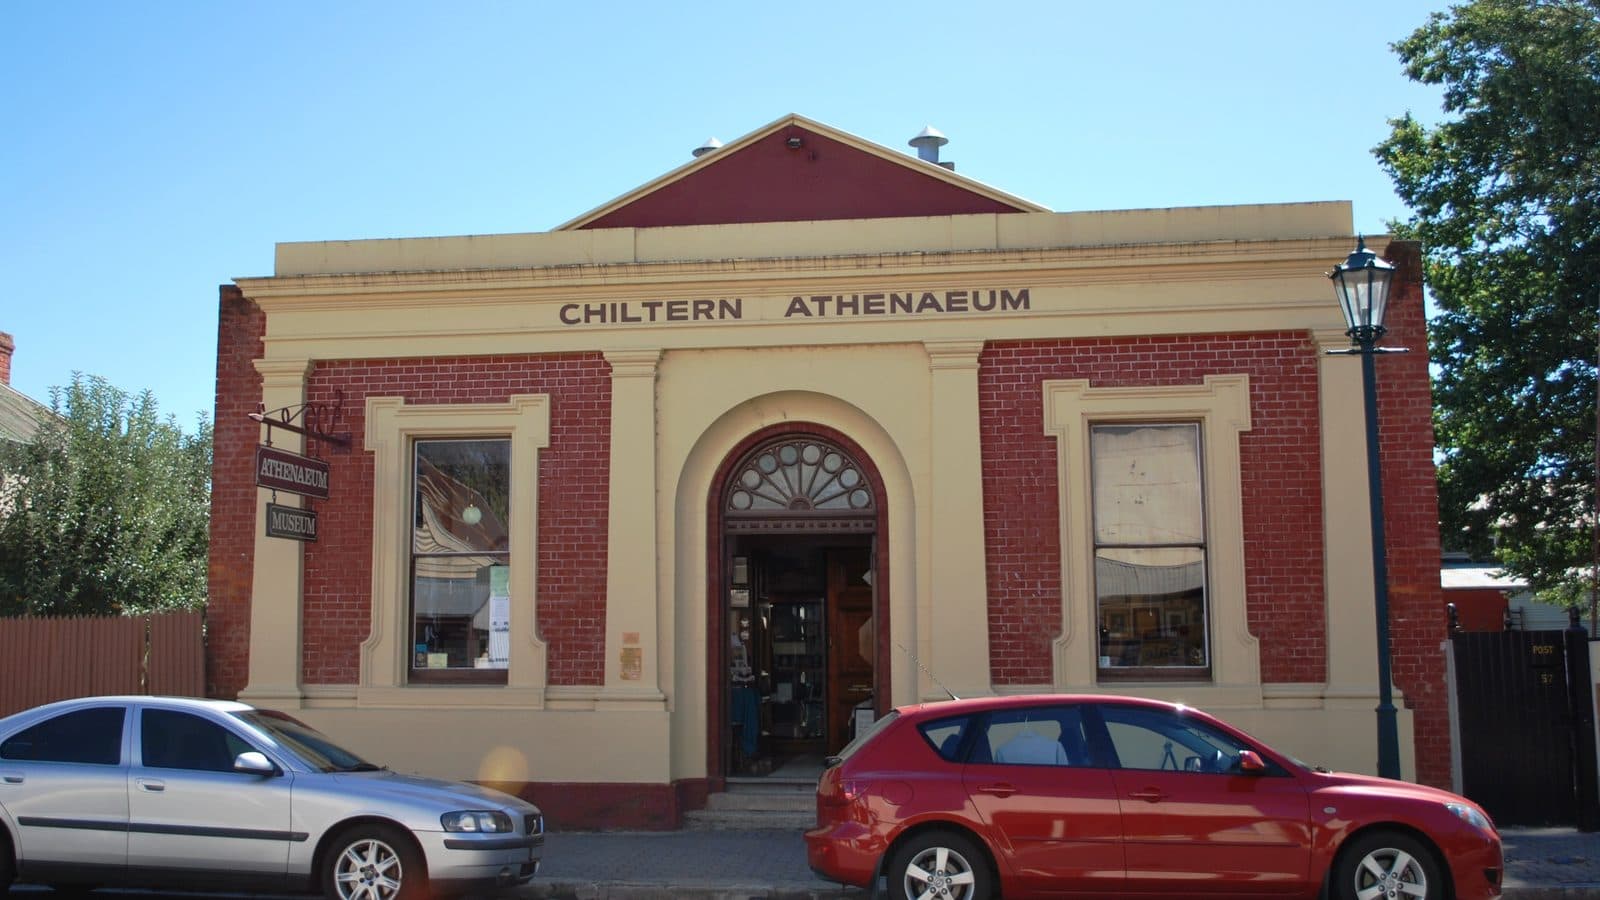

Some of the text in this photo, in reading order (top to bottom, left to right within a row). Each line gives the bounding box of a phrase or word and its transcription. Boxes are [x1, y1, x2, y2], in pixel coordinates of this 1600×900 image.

[559, 288, 1031, 325] CHILTERN ATHENAEUM
[260, 457, 328, 489] ATHENAEUM
[272, 511, 316, 535] MUSEUM
[1532, 645, 1553, 655] POST
